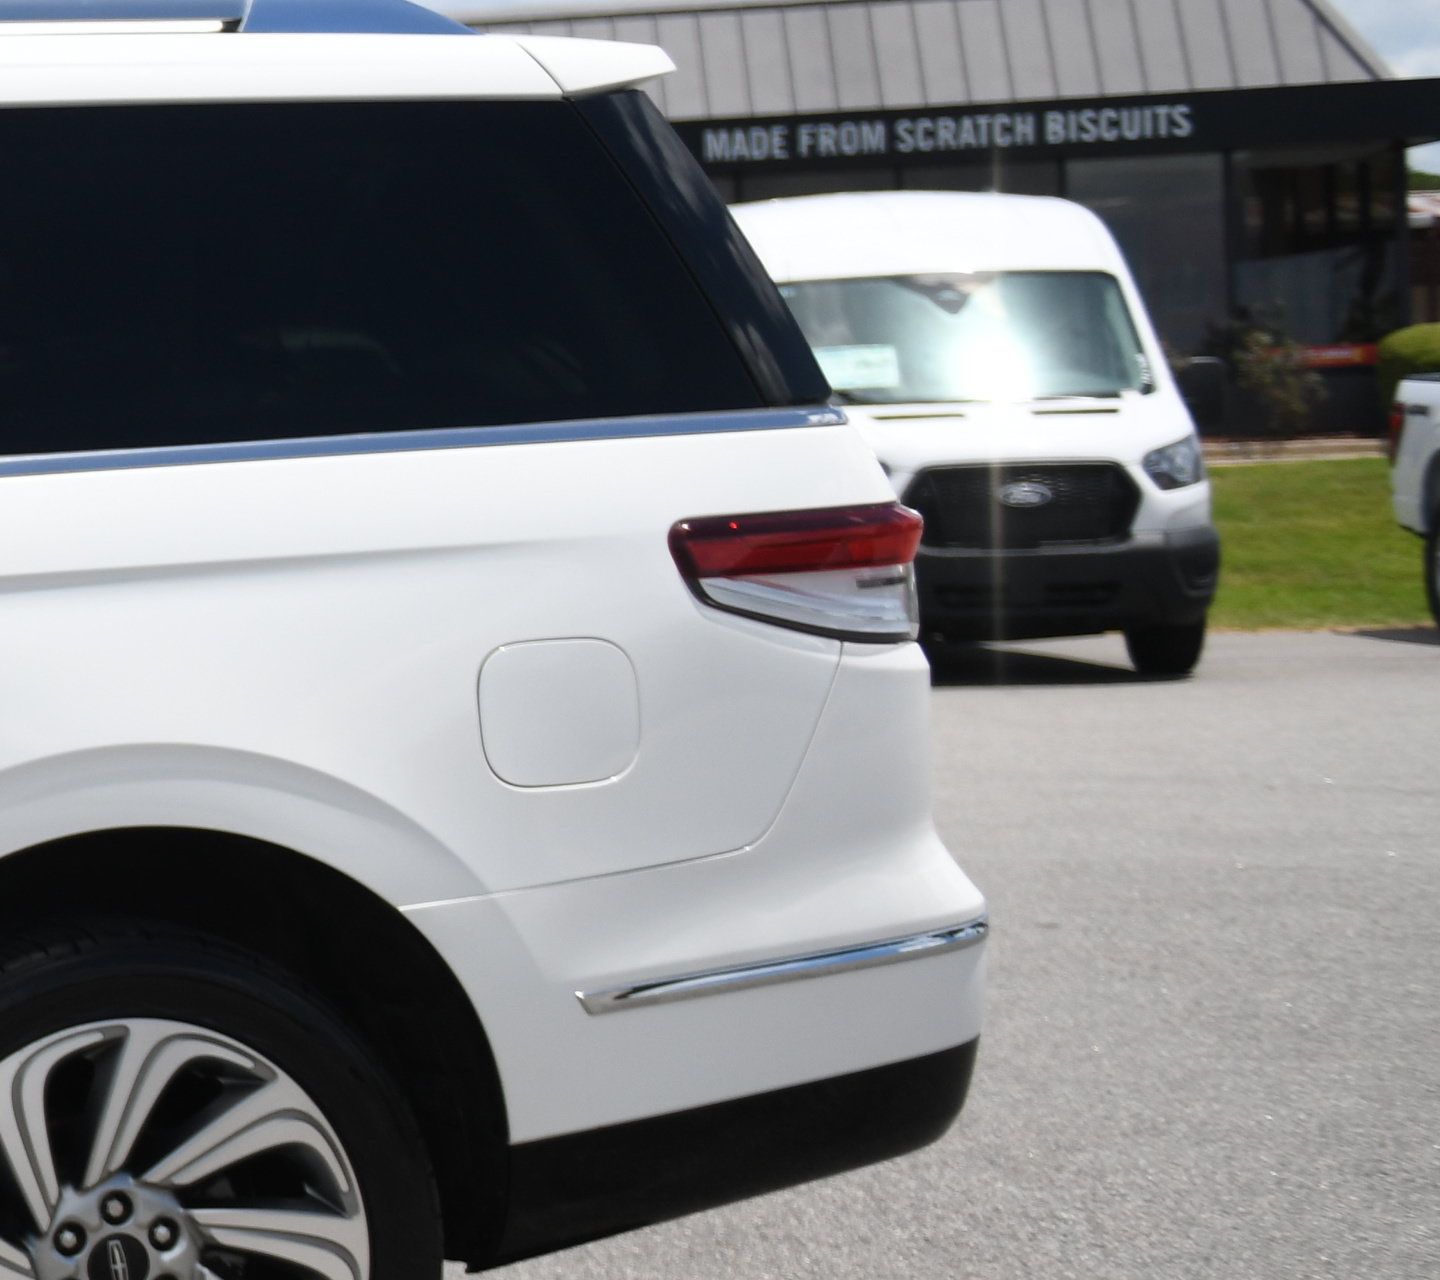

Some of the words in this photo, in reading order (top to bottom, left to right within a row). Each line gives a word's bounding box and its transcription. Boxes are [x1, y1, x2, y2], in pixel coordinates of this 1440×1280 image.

[703, 124, 789, 162] MADE
[797, 120, 885, 157] FROM
[894, 112, 1034, 152] SCRATCH
[1044, 104, 1192, 145] BISCUITS
